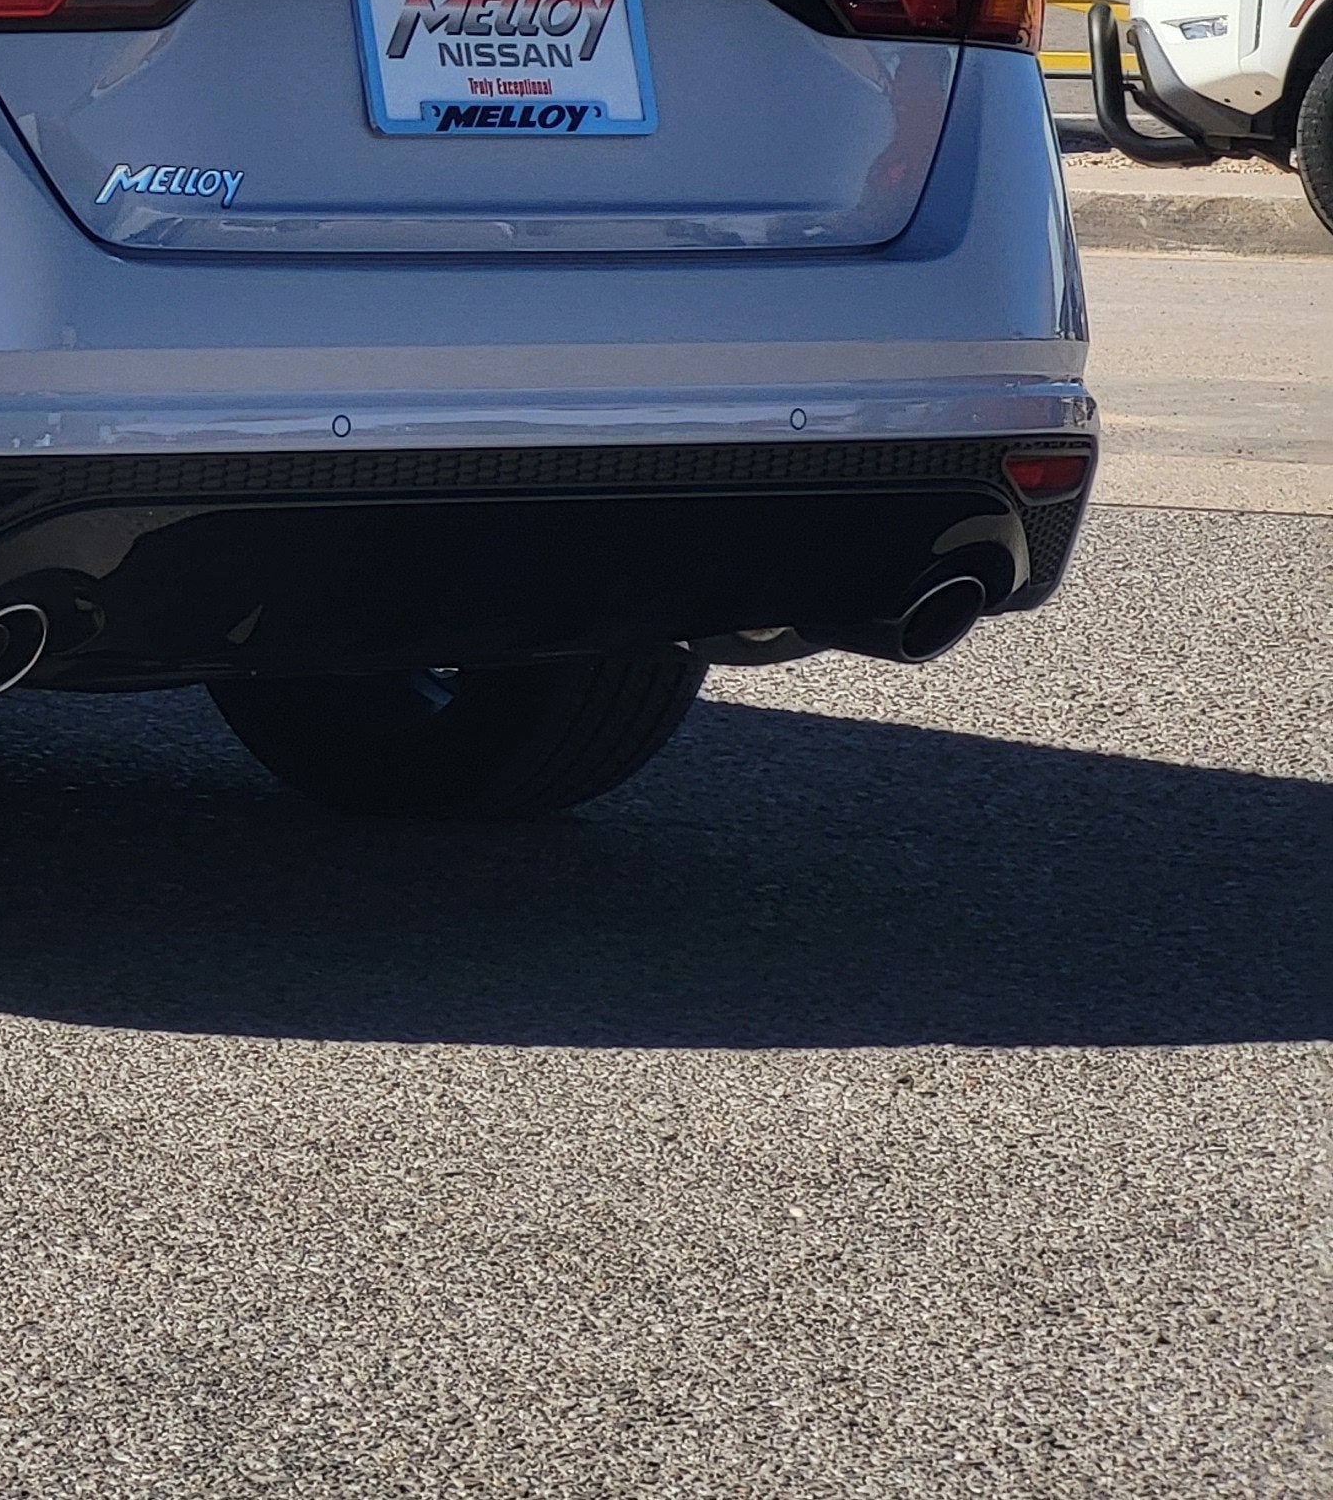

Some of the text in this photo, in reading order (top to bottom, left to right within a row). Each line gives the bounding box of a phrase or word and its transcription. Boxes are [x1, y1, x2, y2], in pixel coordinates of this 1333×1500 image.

[438, 42, 574, 68] NISSAN
[467, 77, 553, 97] Truly Exceptional
[435, 104, 590, 132] MELLOY
[94, 163, 245, 209] MELLOY
